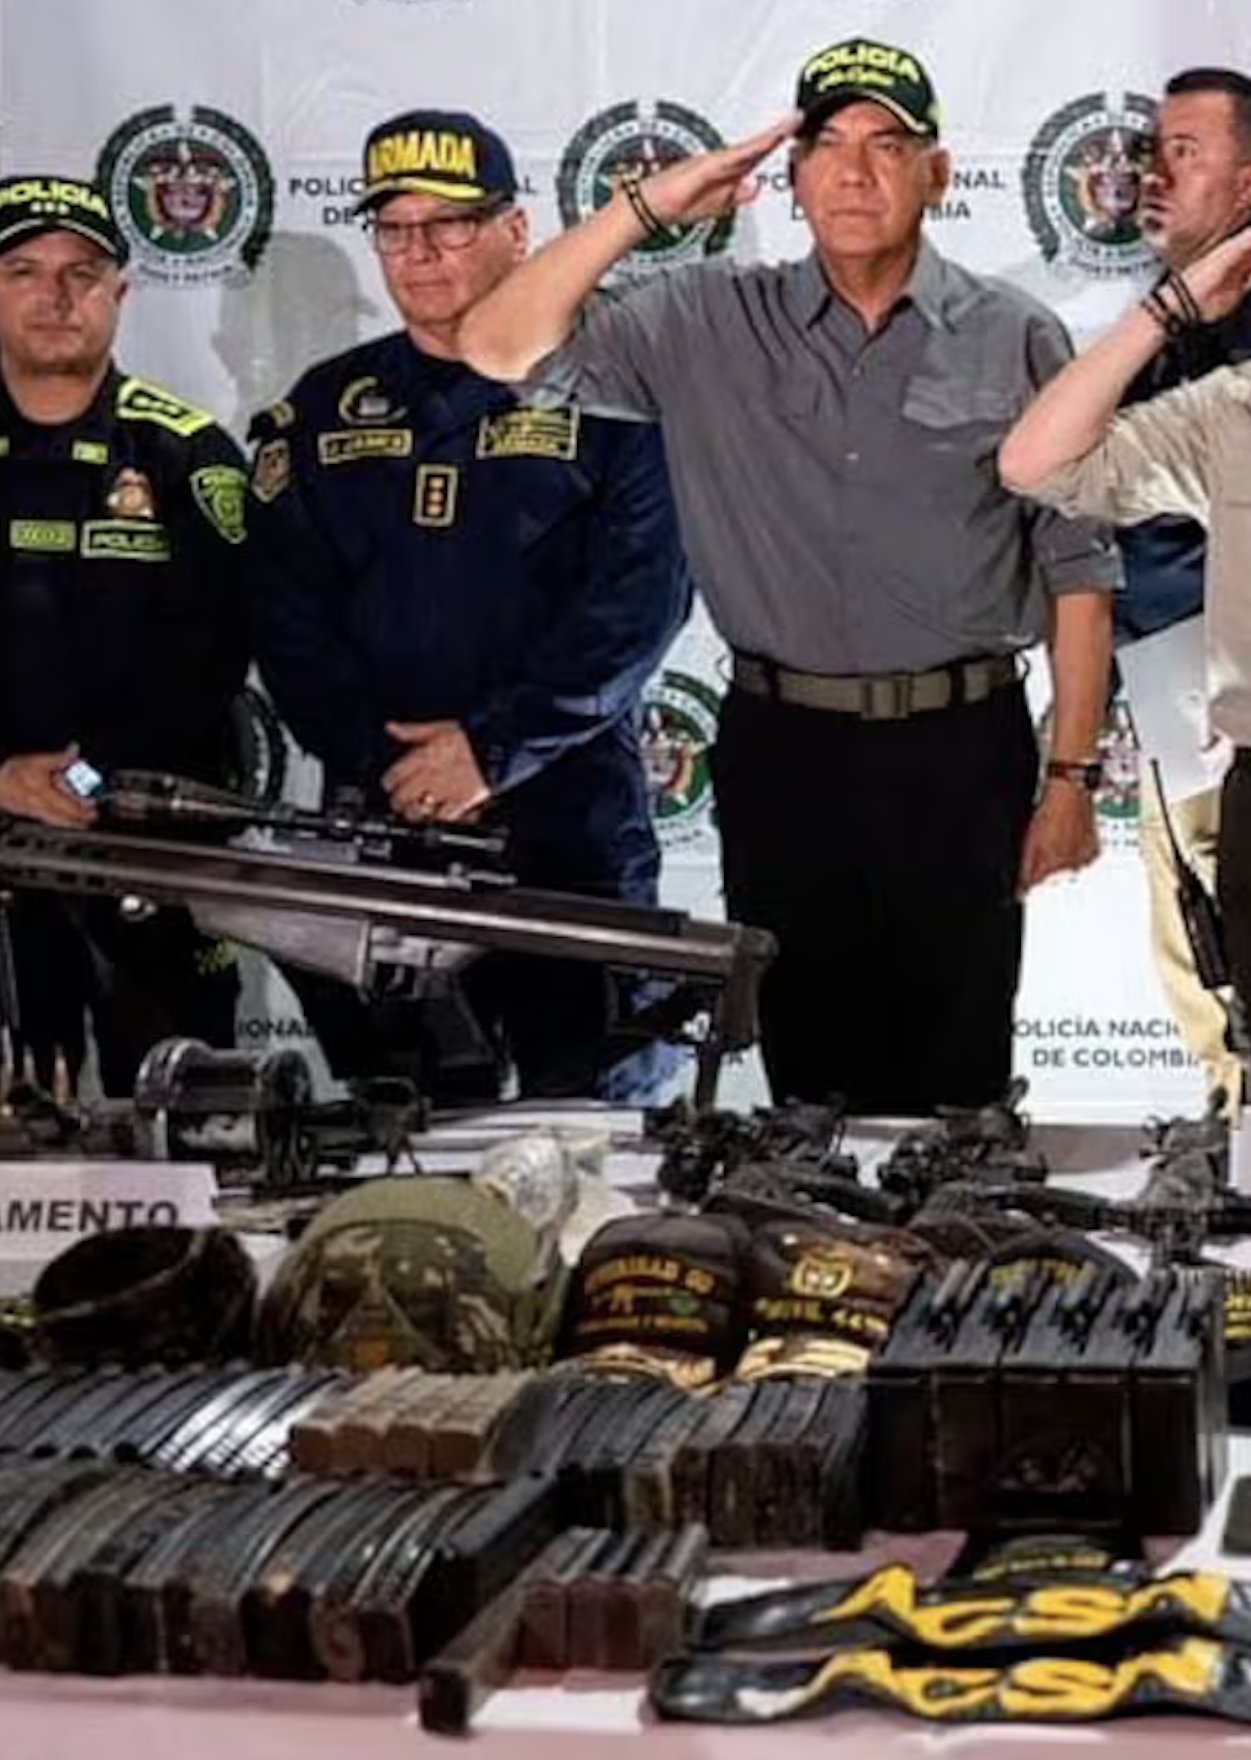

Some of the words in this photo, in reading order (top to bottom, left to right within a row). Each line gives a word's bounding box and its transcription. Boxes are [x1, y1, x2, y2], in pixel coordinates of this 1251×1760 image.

[369, 131, 476, 180] ARMADA
[289, 178, 365, 196] POLIC
[1015, 1015, 1100, 1038] OLICÍA
[1110, 1019, 1183, 1038] NACI
[1032, 1049, 1067, 1067] DE
[0, 1199, 178, 1233] MENTO
